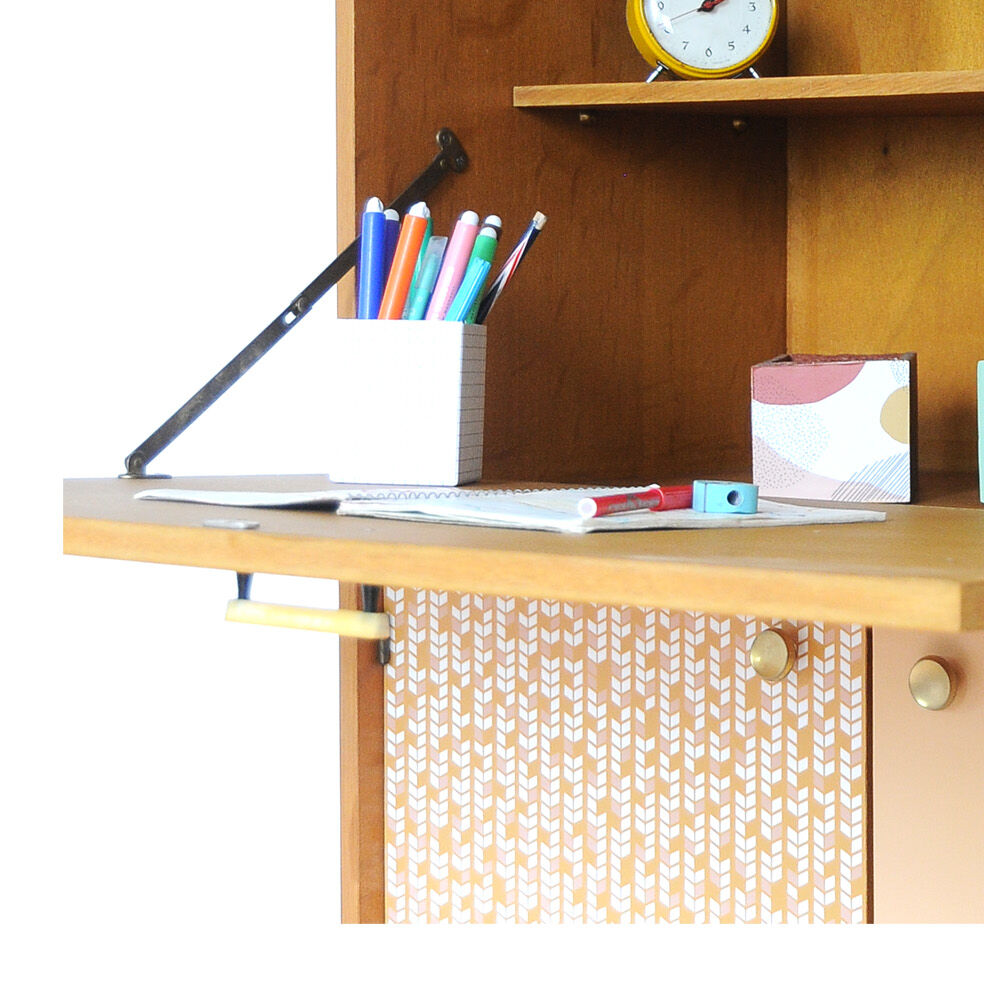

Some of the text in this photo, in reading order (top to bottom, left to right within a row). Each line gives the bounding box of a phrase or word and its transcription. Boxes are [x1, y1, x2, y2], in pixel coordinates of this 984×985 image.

[749, 2, 756, 12] 3
[742, 24, 751, 34] 4
[682, 41, 690, 50] 7
[728, 41, 735, 50] 5
[705, 47, 712, 57] 6
